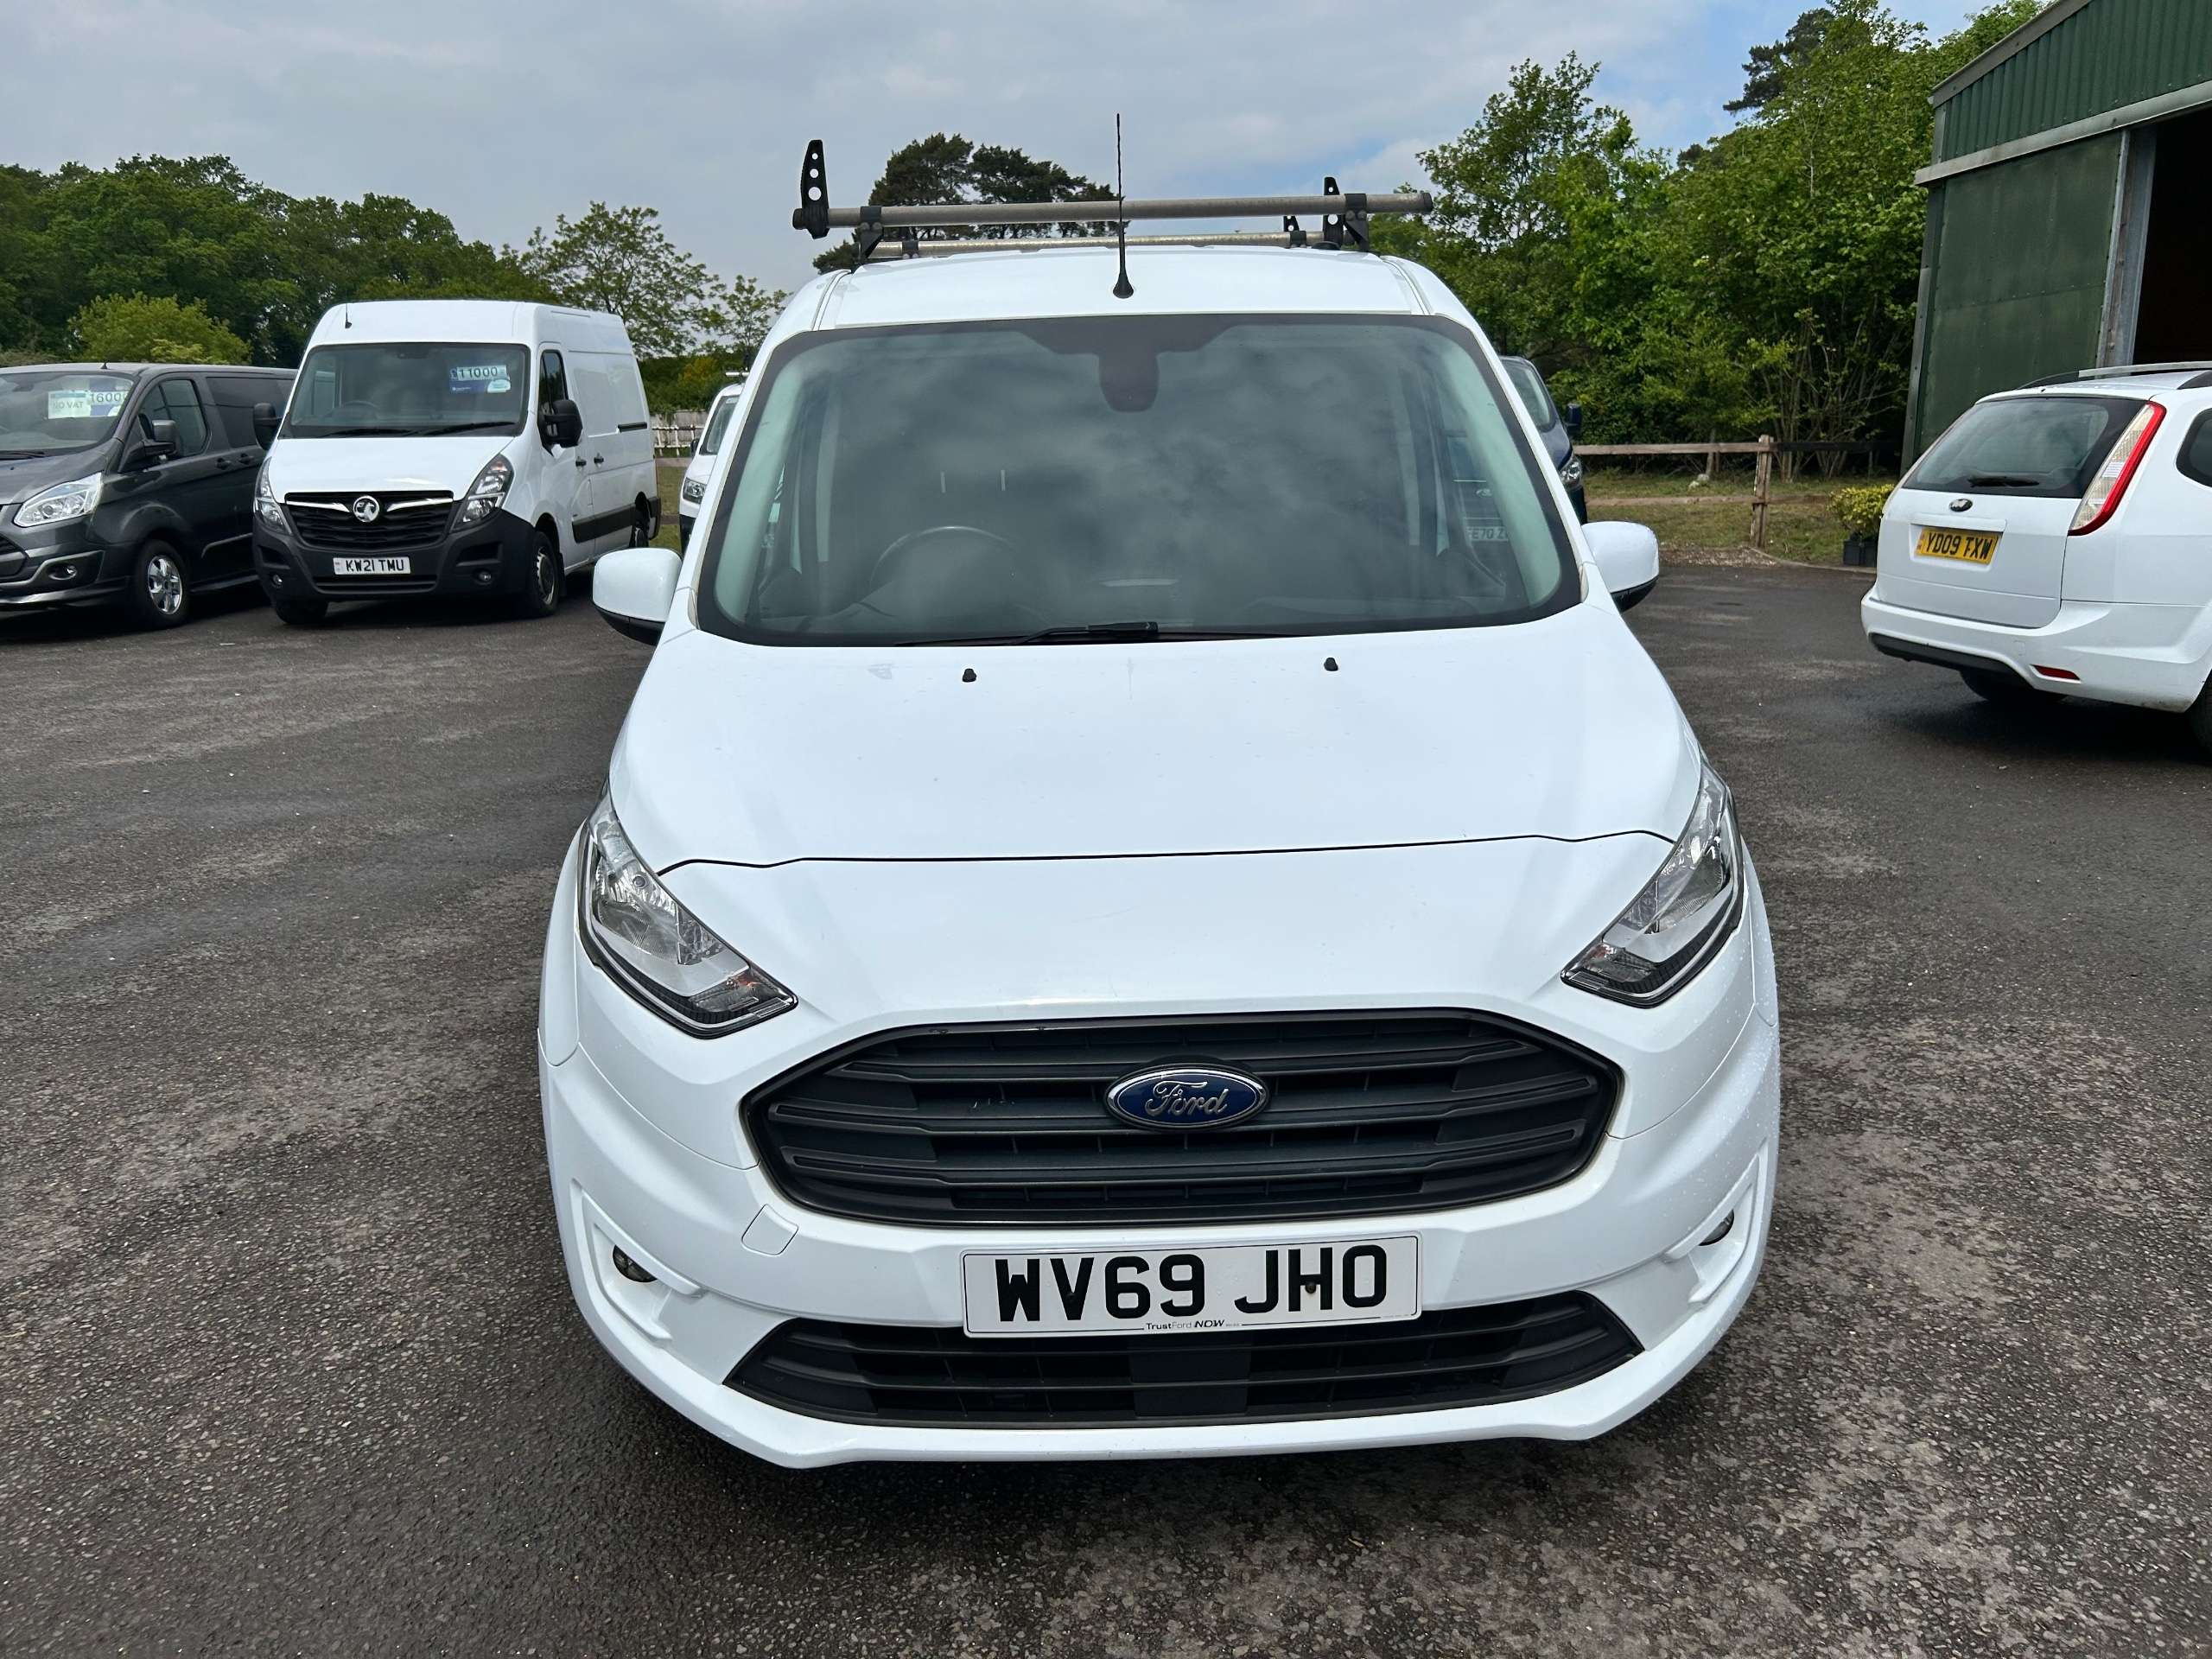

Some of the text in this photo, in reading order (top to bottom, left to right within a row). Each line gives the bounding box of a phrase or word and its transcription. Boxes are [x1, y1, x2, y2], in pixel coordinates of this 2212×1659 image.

[1926, 532, 1961, 555] YD09
[346, 559, 404, 572] KW21 TMU
[1145, 1080, 1229, 1116] Ford
[995, 1244, 1388, 1322] WV69 JHO
[1194, 1319, 1225, 1328] NOW
